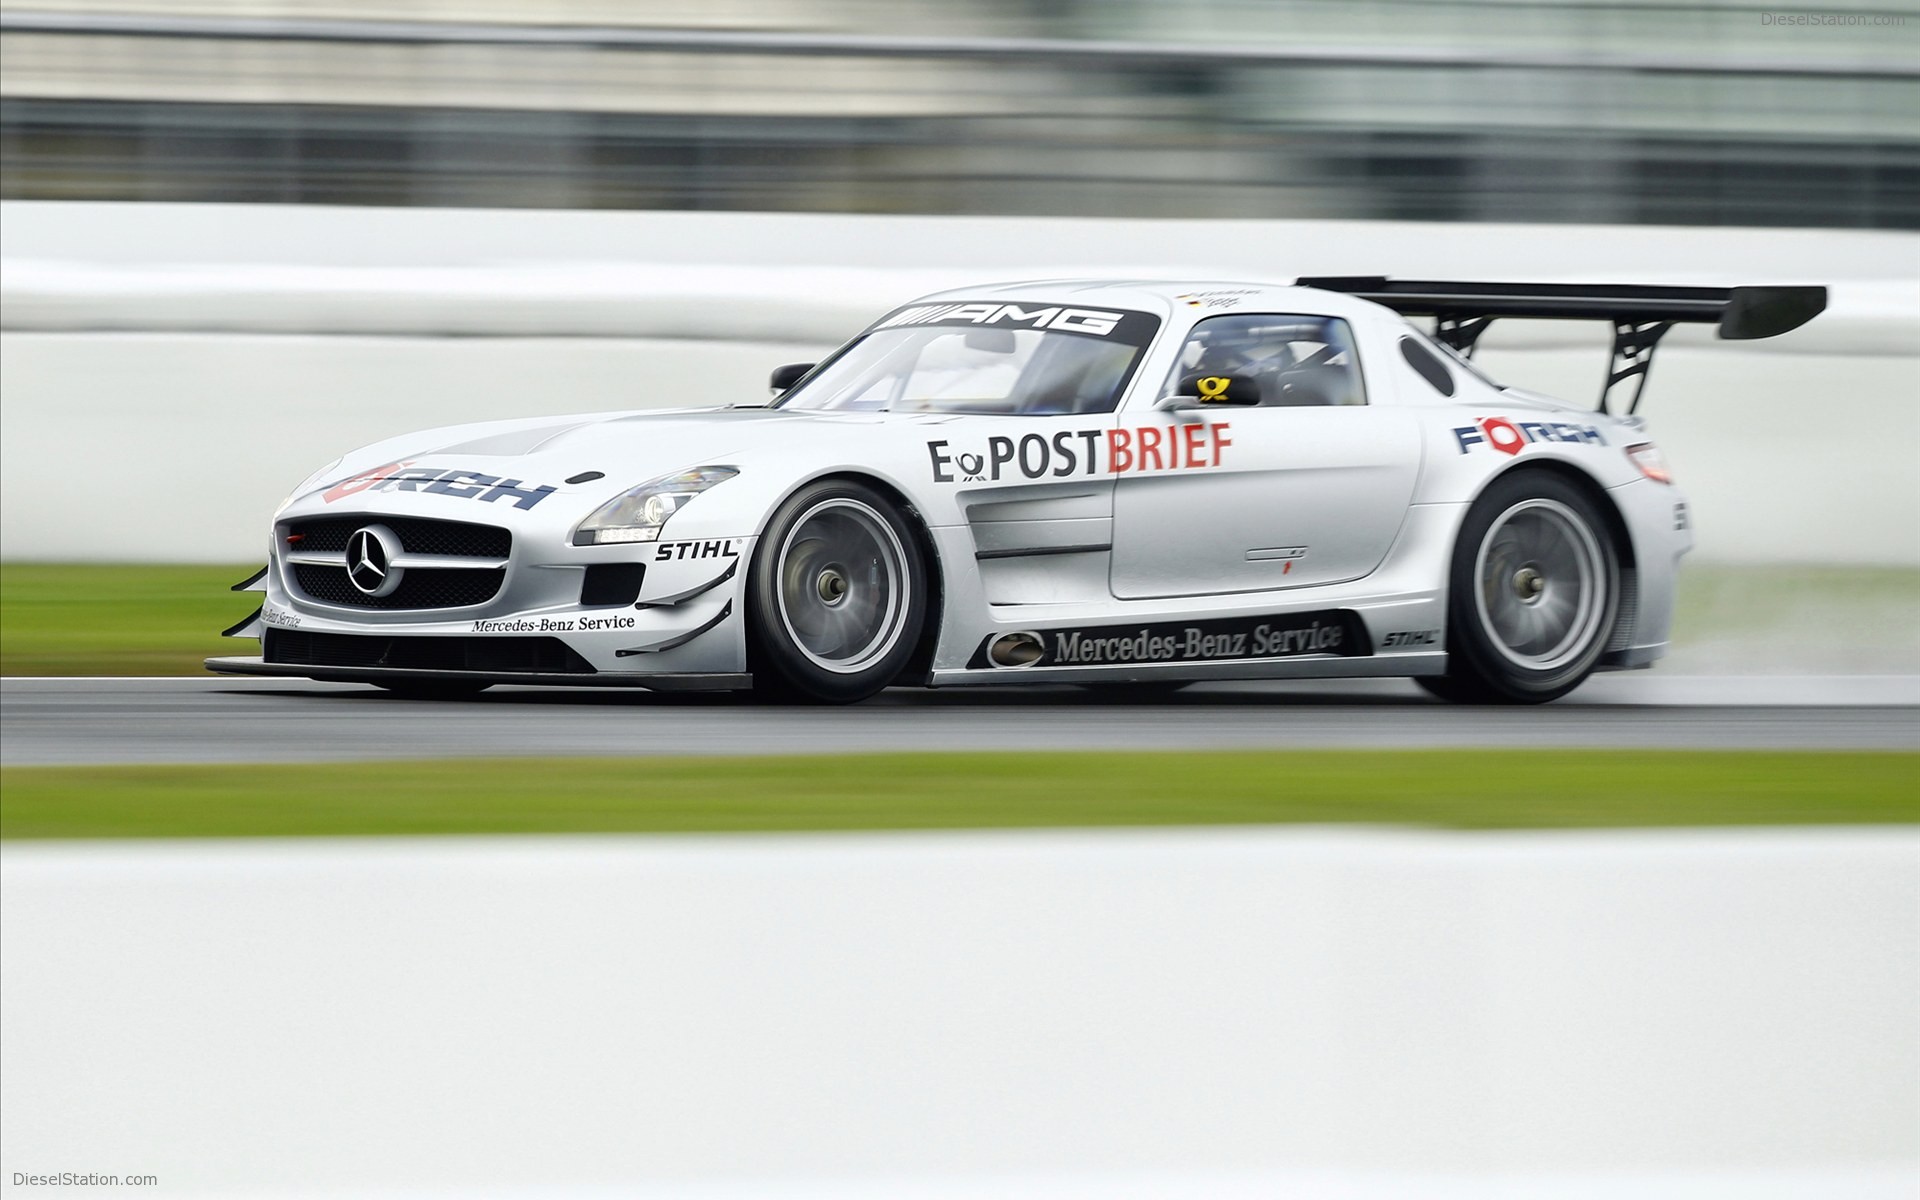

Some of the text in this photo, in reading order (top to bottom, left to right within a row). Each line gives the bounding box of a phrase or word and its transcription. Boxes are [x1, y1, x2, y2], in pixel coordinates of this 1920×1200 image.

[928, 304, 1124, 335] AMG
[472, 615, 635, 633] Mercedes-Benz Service
[1054, 621, 1343, 663] Mercedes-Benz Service
[1381, 630, 1436, 647] STIHL
